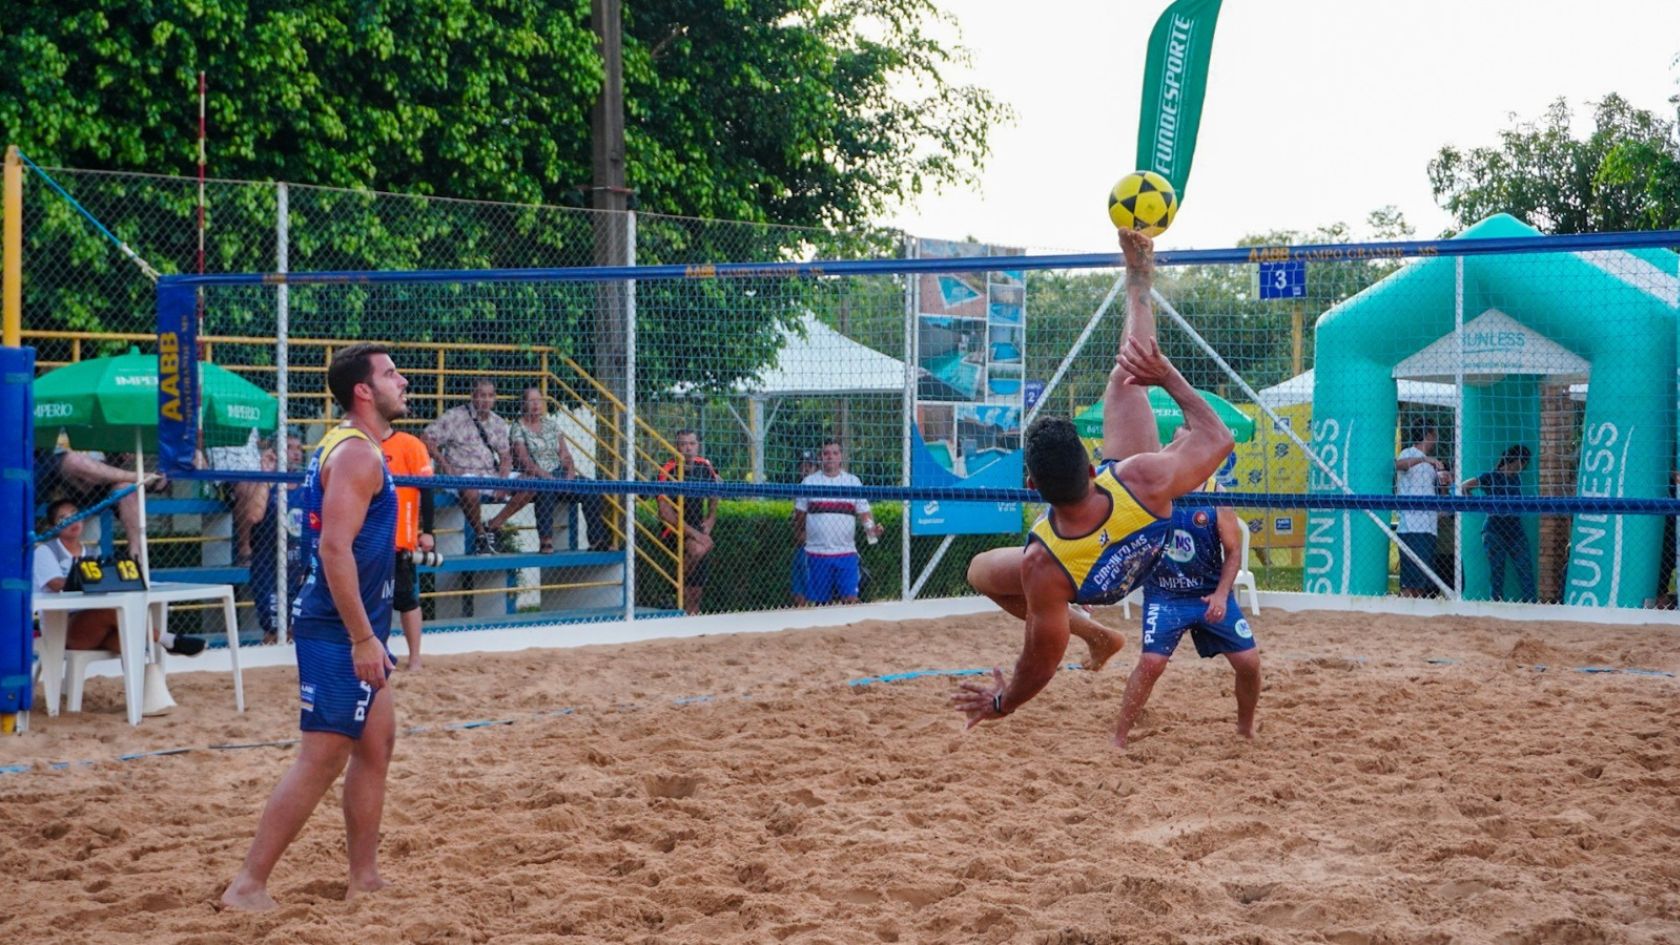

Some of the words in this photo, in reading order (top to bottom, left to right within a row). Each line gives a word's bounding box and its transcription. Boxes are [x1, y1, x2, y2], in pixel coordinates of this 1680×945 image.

[1155, 13, 1191, 175] FUNDESPORTE
[1248, 246, 1290, 263] AABB
[1275, 270, 1287, 289] 3
[115, 376, 159, 386] IMPE
[160, 331, 183, 422] AABB
[34, 403, 73, 418] MPERIO
[1306, 418, 1340, 595] SUNESS
[1175, 535, 1192, 552] MS
[81, 561, 102, 580] 15
[117, 560, 139, 580] 13
